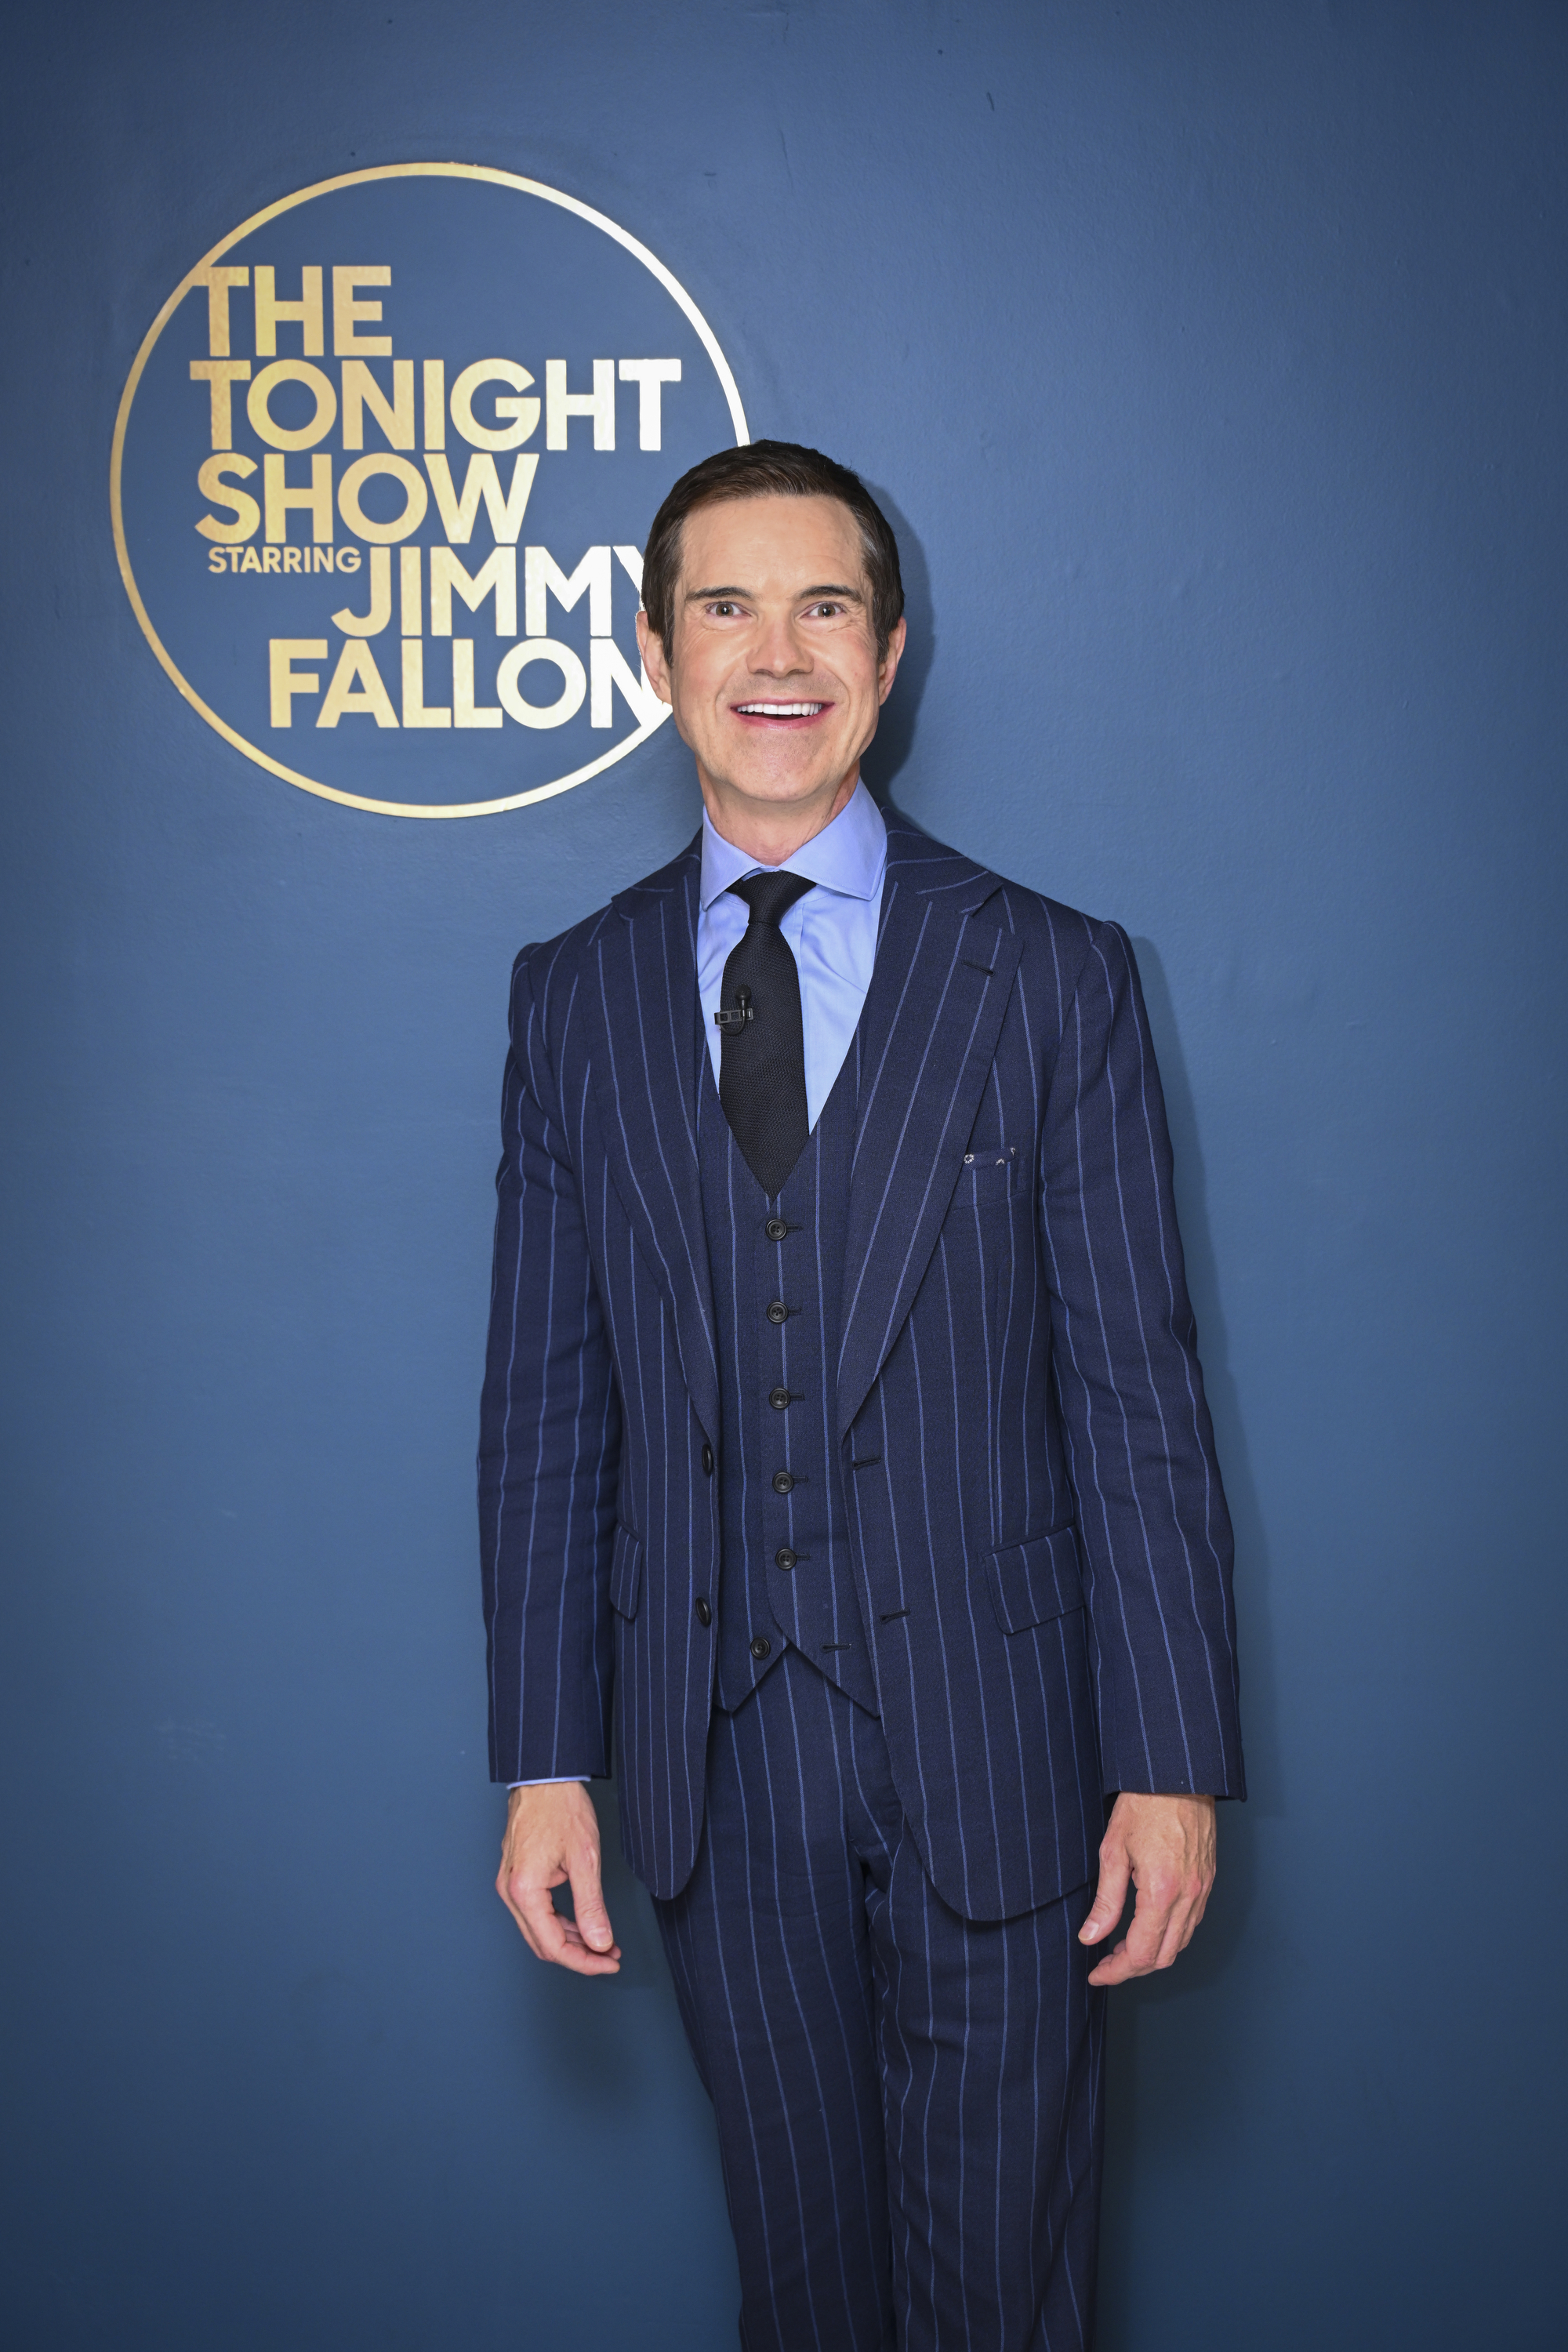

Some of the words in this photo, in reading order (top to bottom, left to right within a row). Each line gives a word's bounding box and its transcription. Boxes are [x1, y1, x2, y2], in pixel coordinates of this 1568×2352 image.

[188, 266, 392, 357] THE
[190, 358, 682, 452] TONIGHT
[194, 452, 539, 544] SHOW
[208, 546, 361, 573] STARRING
[269, 637, 664, 729] FALLON
